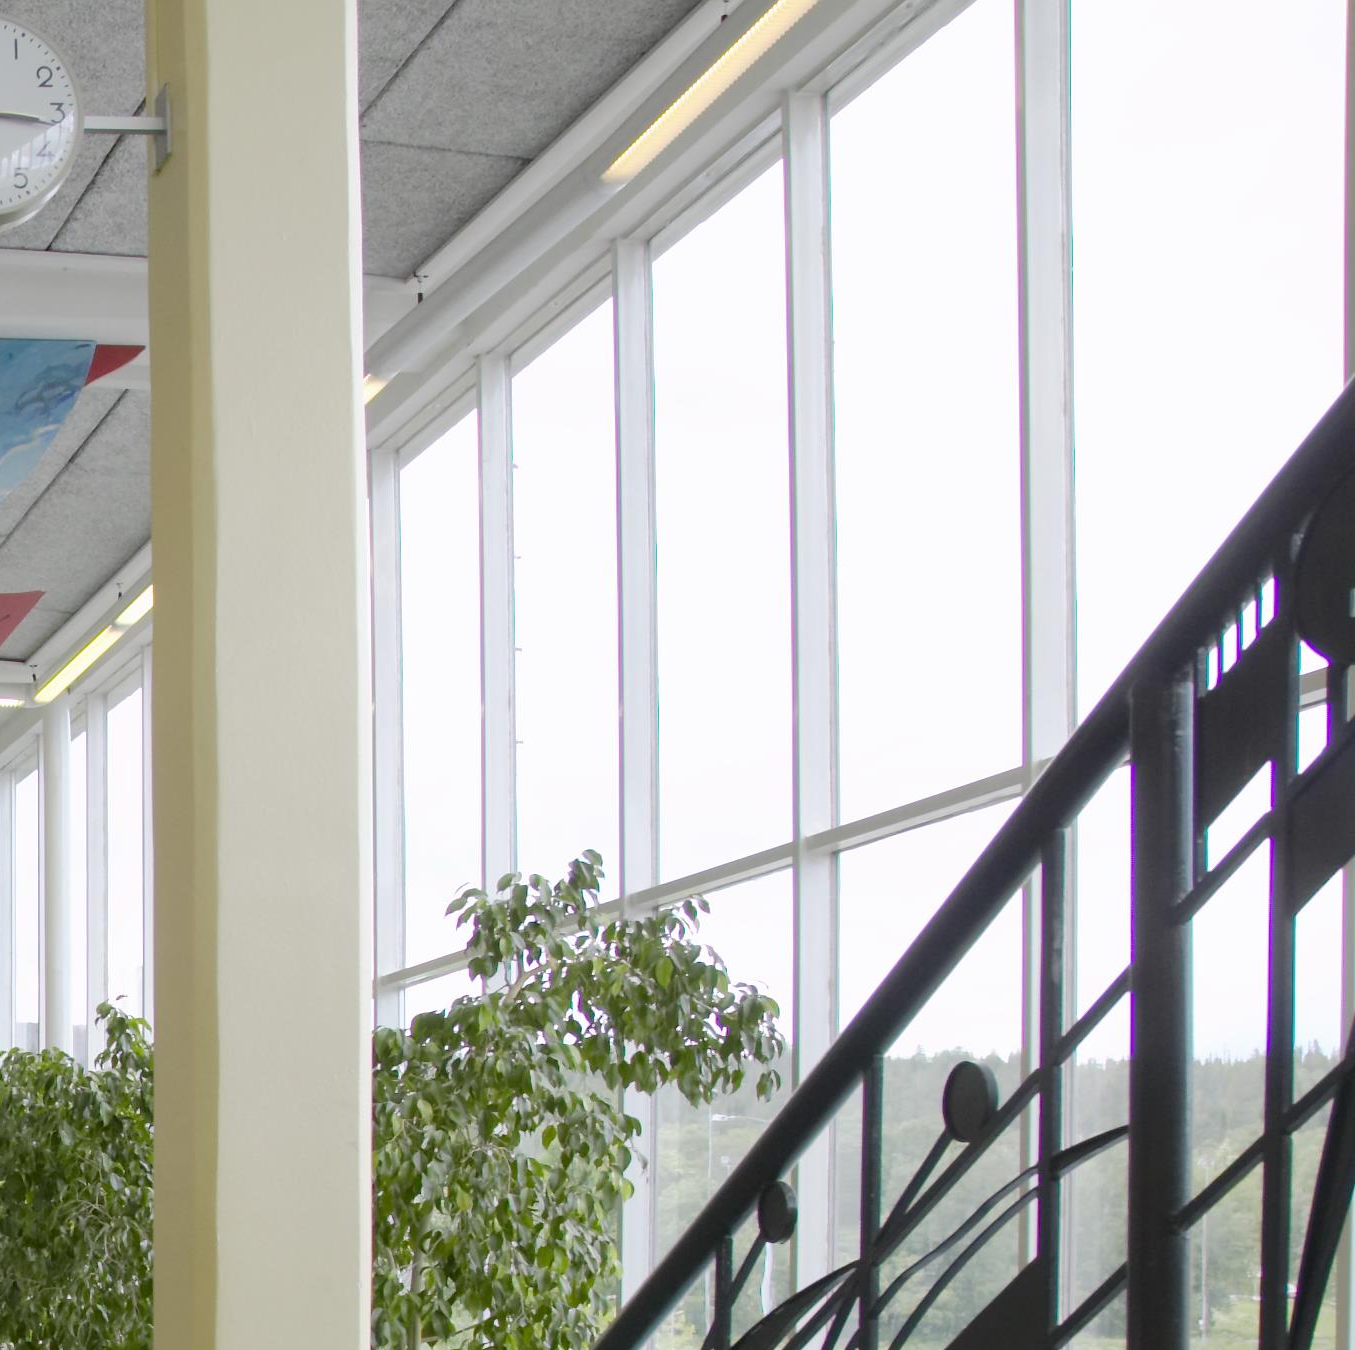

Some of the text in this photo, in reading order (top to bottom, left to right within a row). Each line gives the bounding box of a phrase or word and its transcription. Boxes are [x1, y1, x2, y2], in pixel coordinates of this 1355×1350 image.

[36, 65, 53, 88] 2
[49, 102, 66, 124] 3
[36, 139, 55, 157] 4
[13, 167, 29, 189] 5
